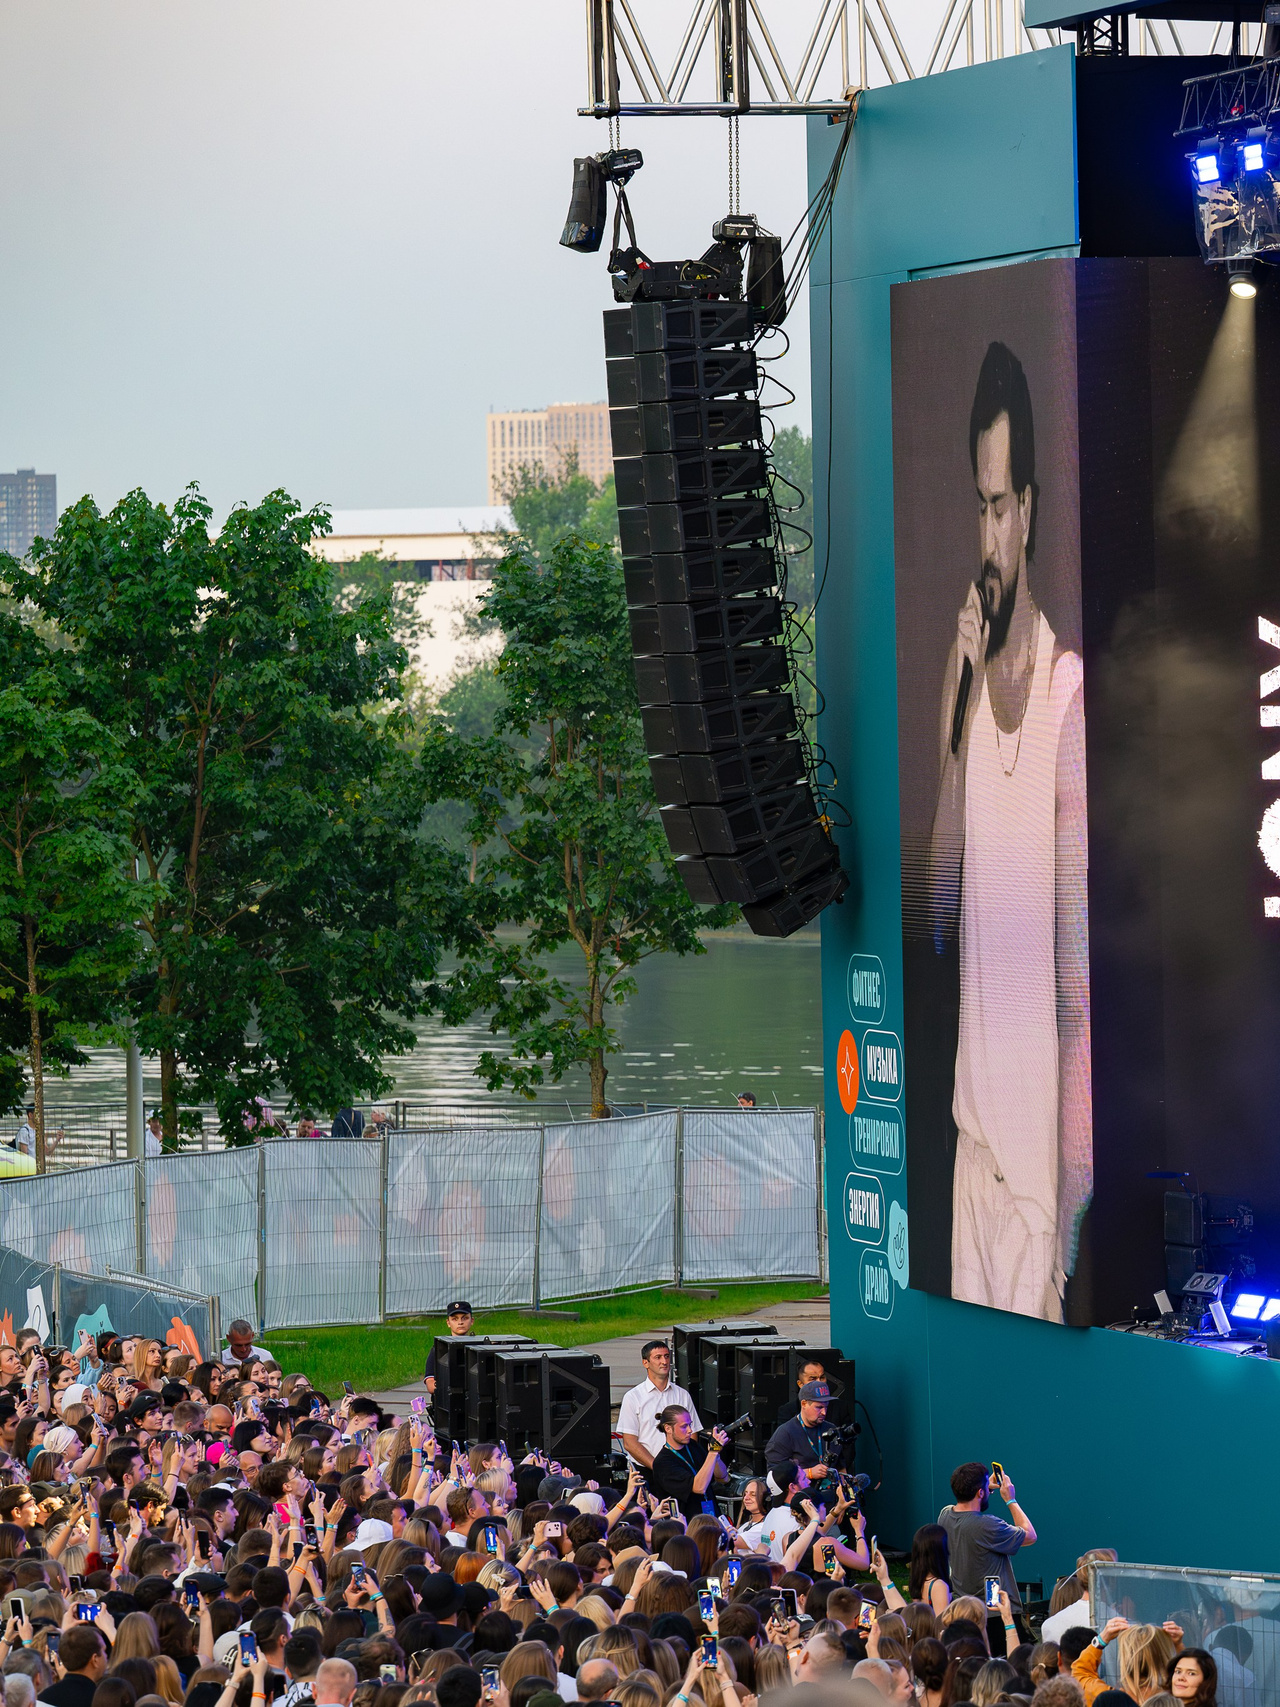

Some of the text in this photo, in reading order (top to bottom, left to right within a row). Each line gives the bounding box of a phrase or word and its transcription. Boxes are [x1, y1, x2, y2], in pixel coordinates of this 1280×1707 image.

[852, 968, 881, 1009] ФИТНЕС
[867, 1044, 898, 1085] МУЗЫКА
[853, 1116, 900, 1159] ТРЕНИРОВКИ
[848, 1188, 880, 1229] ЭНЕРГИЯ
[864, 1260, 889, 1304] ДРАЙВ
